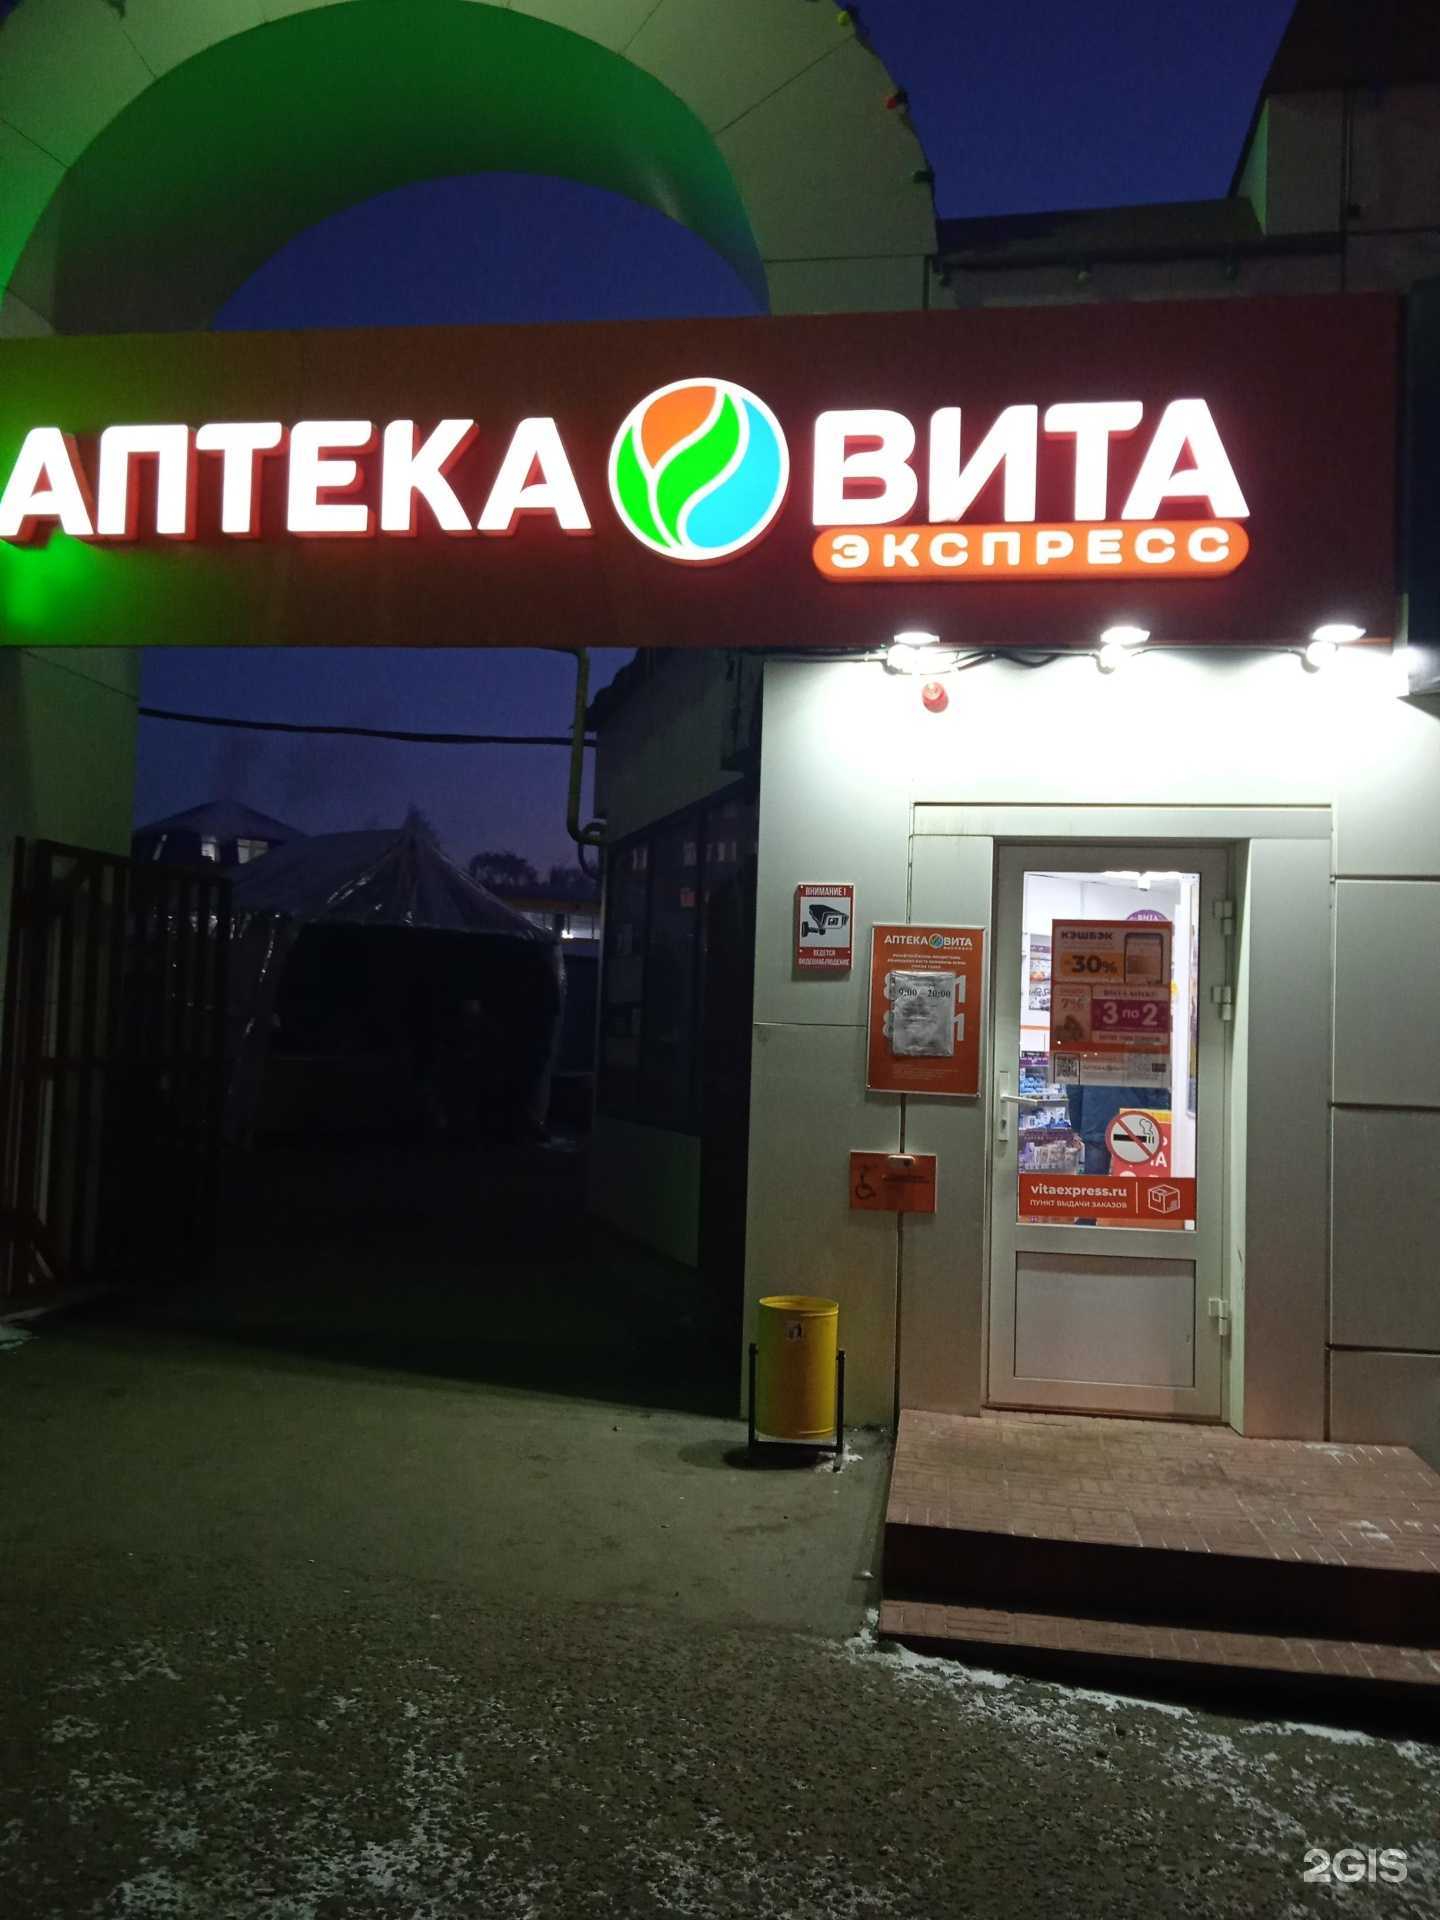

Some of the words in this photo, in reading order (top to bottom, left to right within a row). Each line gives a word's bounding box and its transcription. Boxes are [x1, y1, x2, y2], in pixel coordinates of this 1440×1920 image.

[0, 416, 594, 538] АПТЕКА
[812, 398, 1251, 526] ВИТА
[830, 528, 1231, 568] ЭКСПРЕСС
[884, 935, 928, 945] АПТЕКА
[943, 937, 973, 947] ВИТА
[1061, 931, 1113, 940] КЭШБЭК
[1103, 1001, 1119, 1024] 3
[1122, 1008, 1140, 1018] по
[1142, 1003, 1158, 1026] 2
[1030, 1183, 1128, 1198] vitaexpress.ru
[1056, 1200, 1090, 1208] ВЫДАЧИ
[1091, 1201, 1128, 1209] ЗАКАЗОВ
